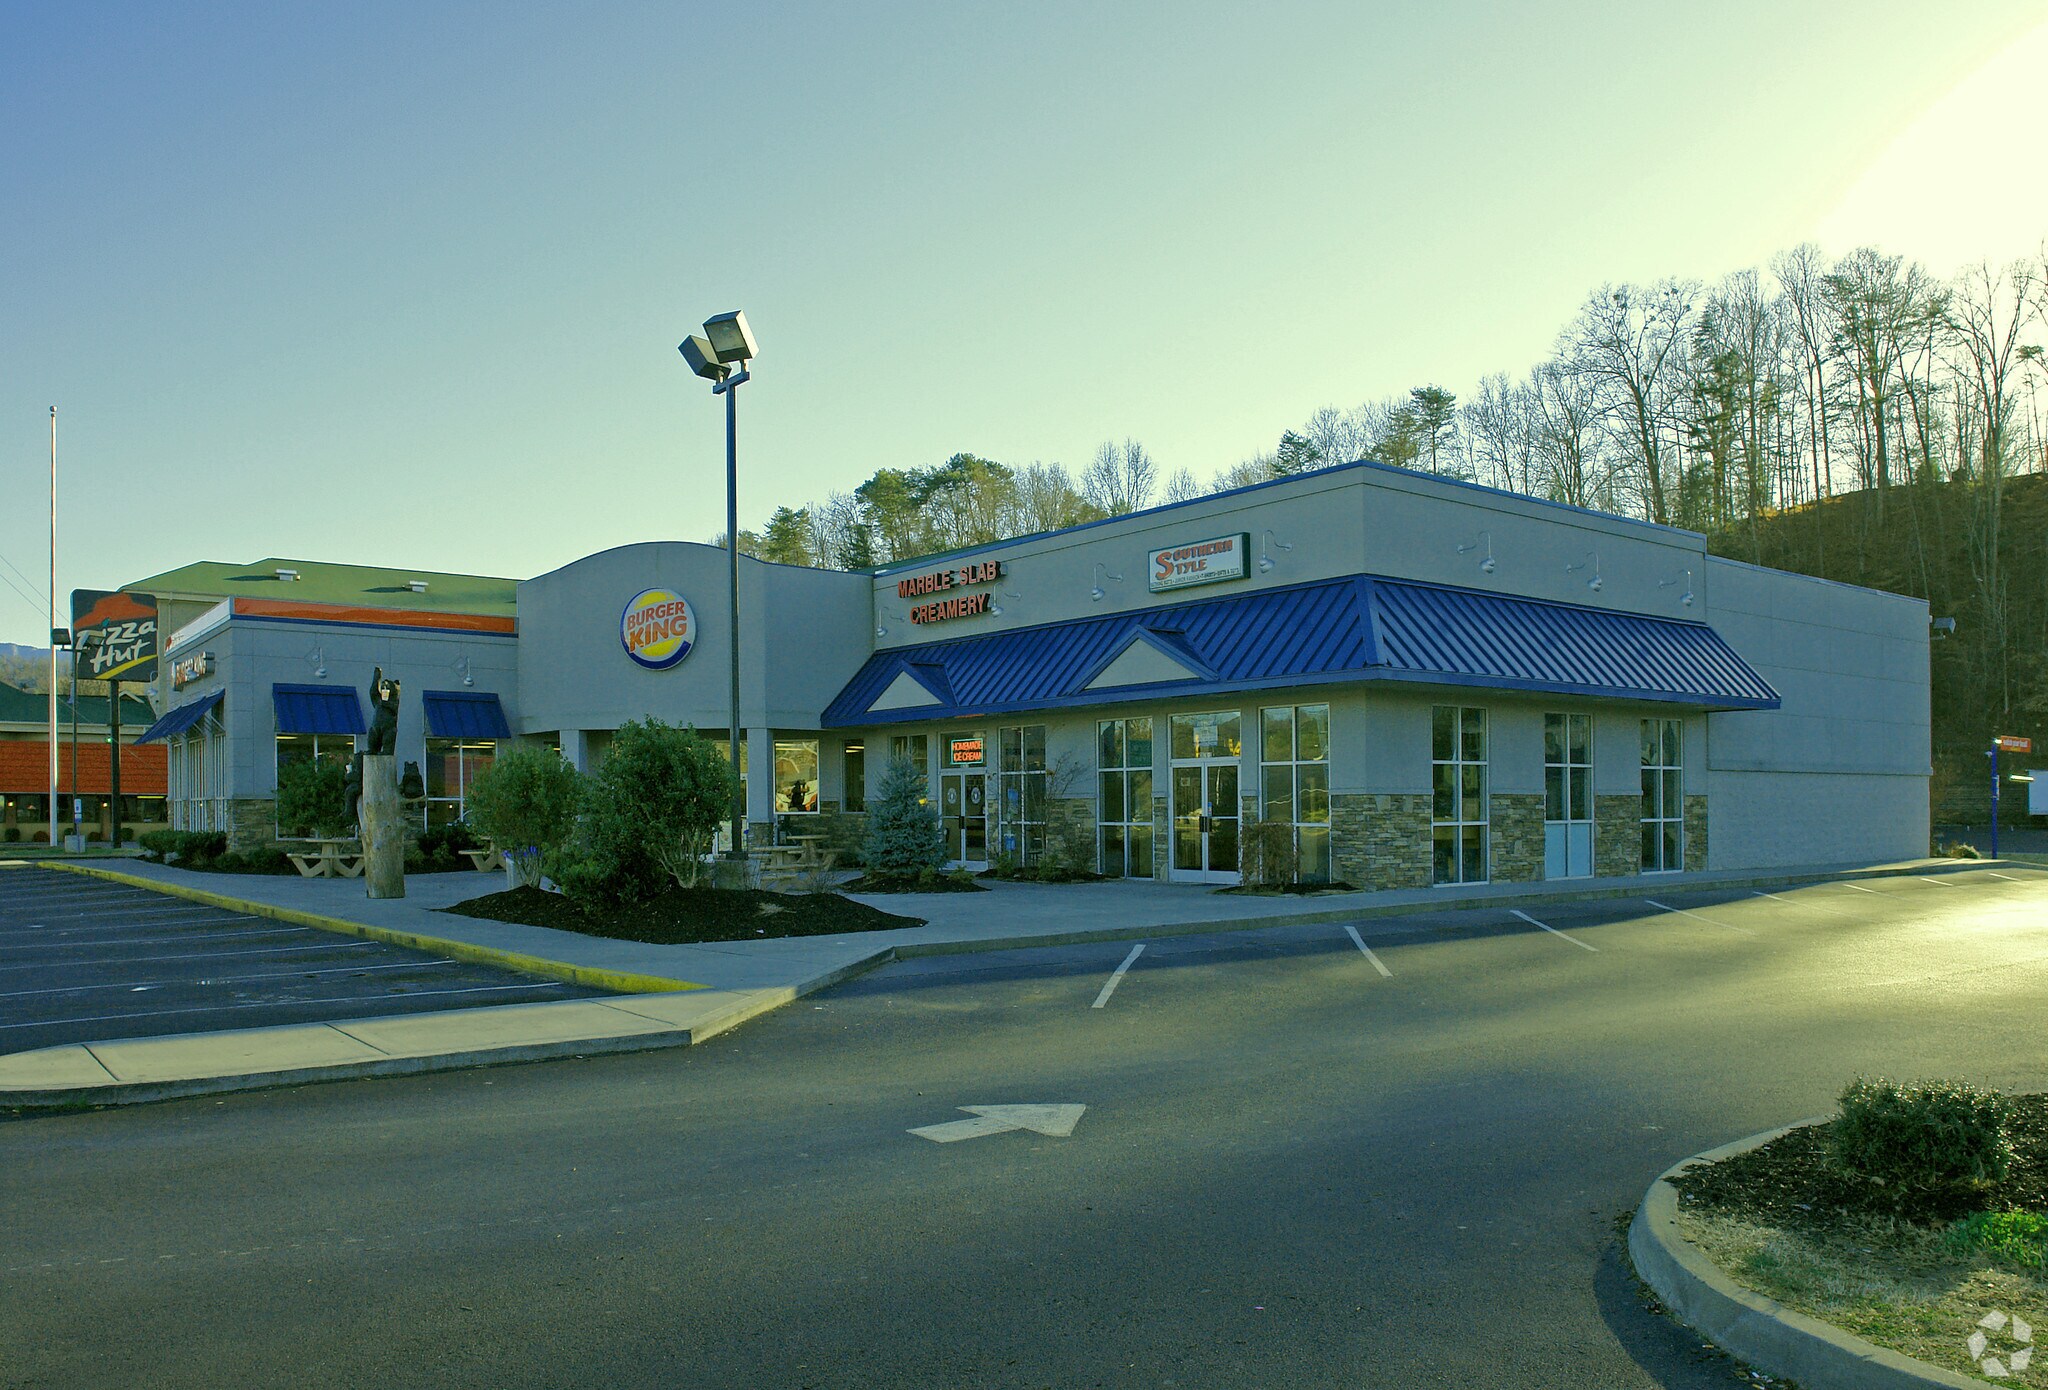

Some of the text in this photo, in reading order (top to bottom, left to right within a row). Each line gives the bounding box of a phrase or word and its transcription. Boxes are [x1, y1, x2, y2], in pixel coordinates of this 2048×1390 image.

[898, 560, 999, 598] MARBLE SLAB
[627, 601, 685, 631] BURGER
[910, 592, 989, 624] CREAMERY
[76, 618, 158, 664] Pizza
[629, 615, 687, 652] KING
[90, 639, 151, 673] Hut
